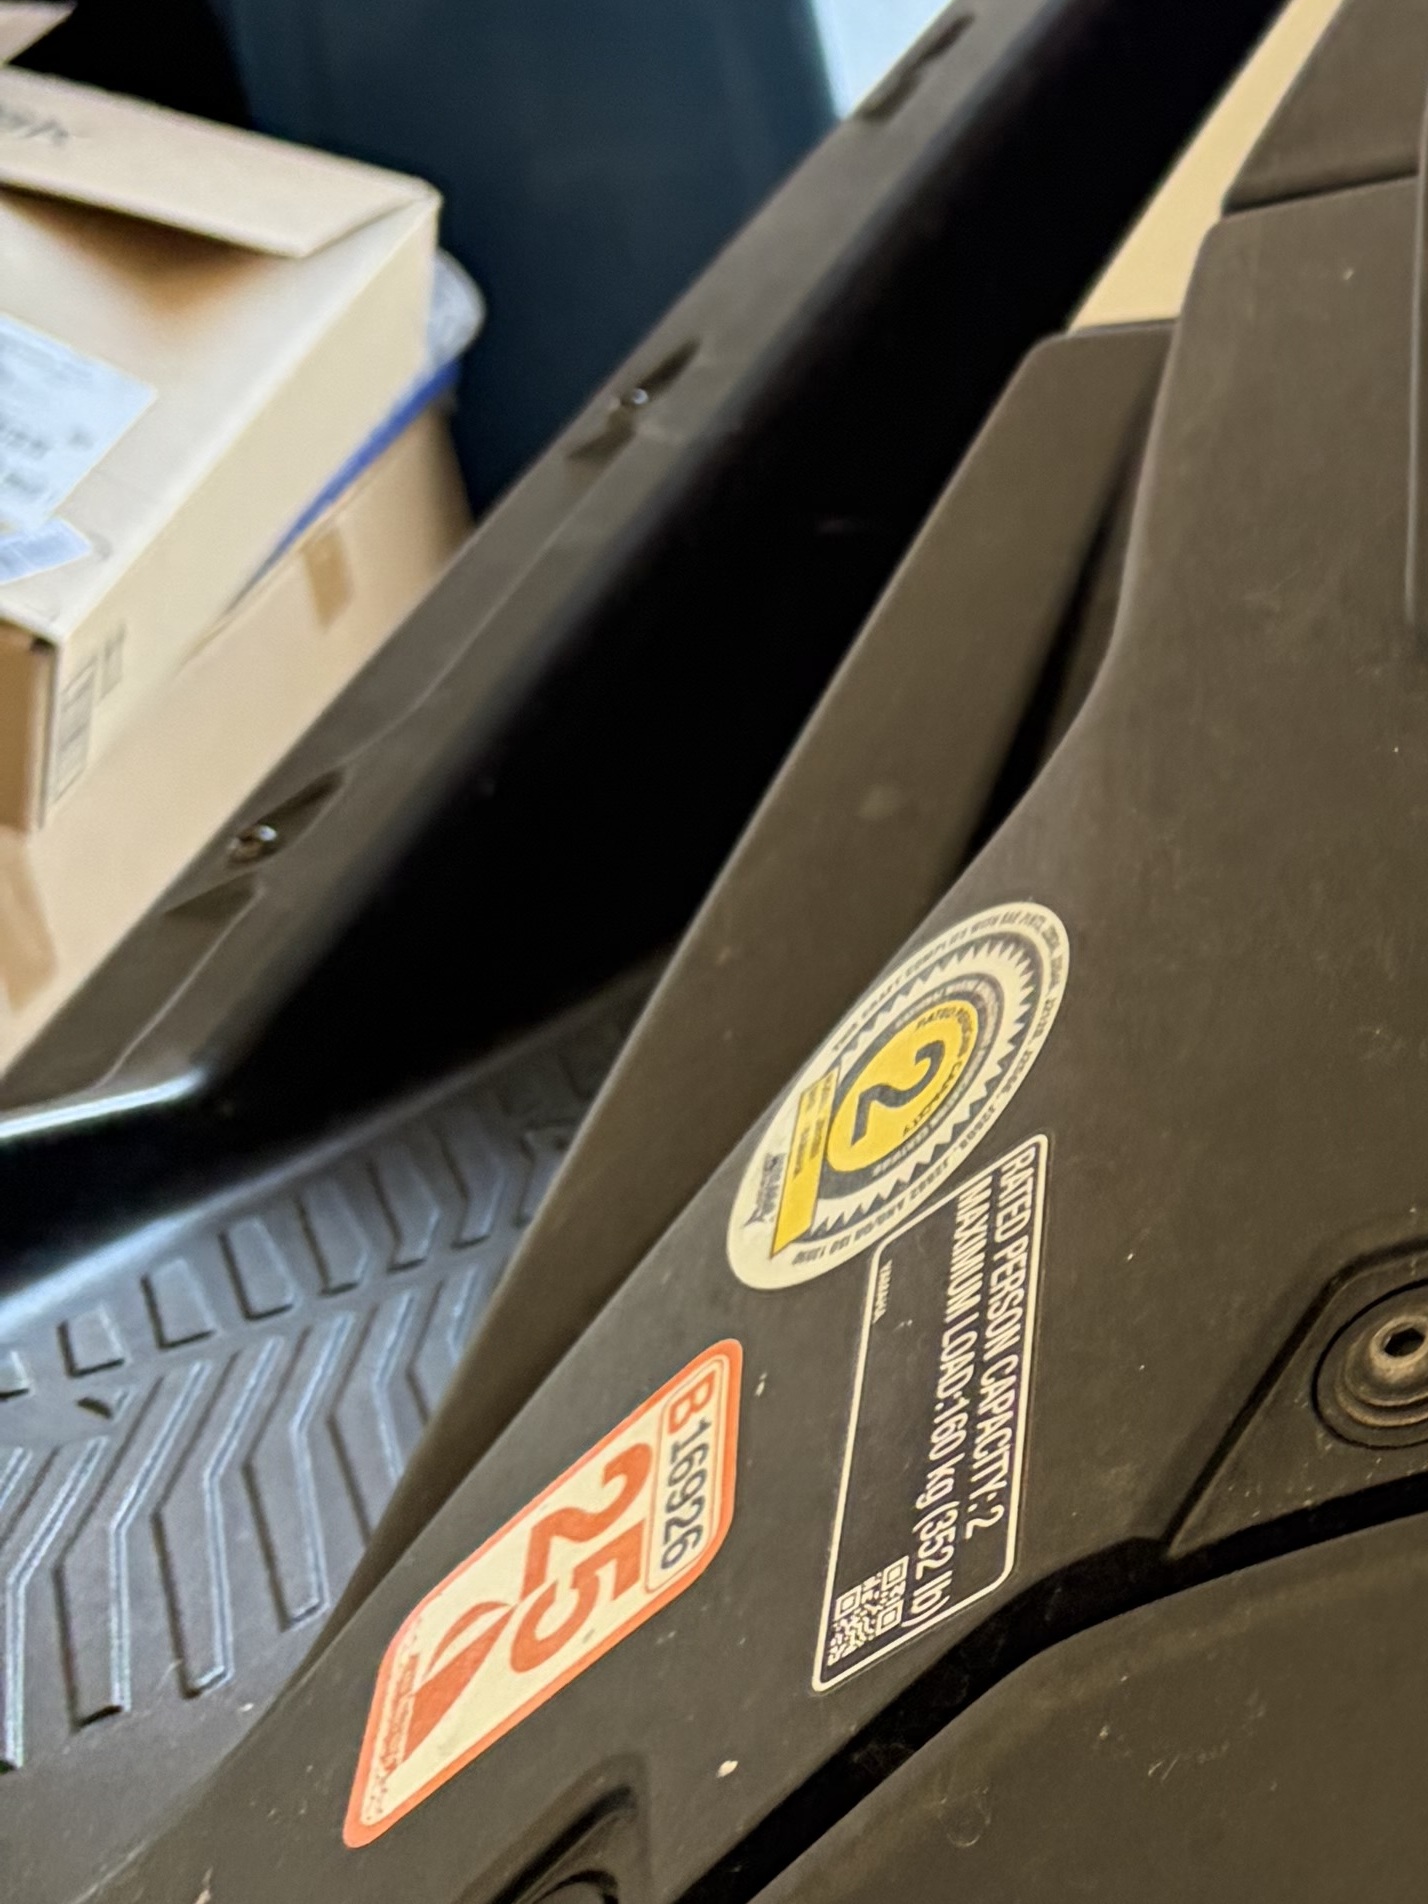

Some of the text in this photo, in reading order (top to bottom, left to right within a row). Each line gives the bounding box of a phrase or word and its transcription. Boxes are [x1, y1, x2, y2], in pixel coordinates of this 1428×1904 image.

[850, 1039, 946, 1148] 2
[944, 1175, 994, 1324] MAXIMUM
[964, 1146, 1037, 1541] RATED PERSON CAPACITY: 2
[914, 1452, 966, 1510] kg
[510, 1442, 654, 1674] 25
[911, 1500, 961, 1581] (352
[900, 1570, 955, 1628] lb)
